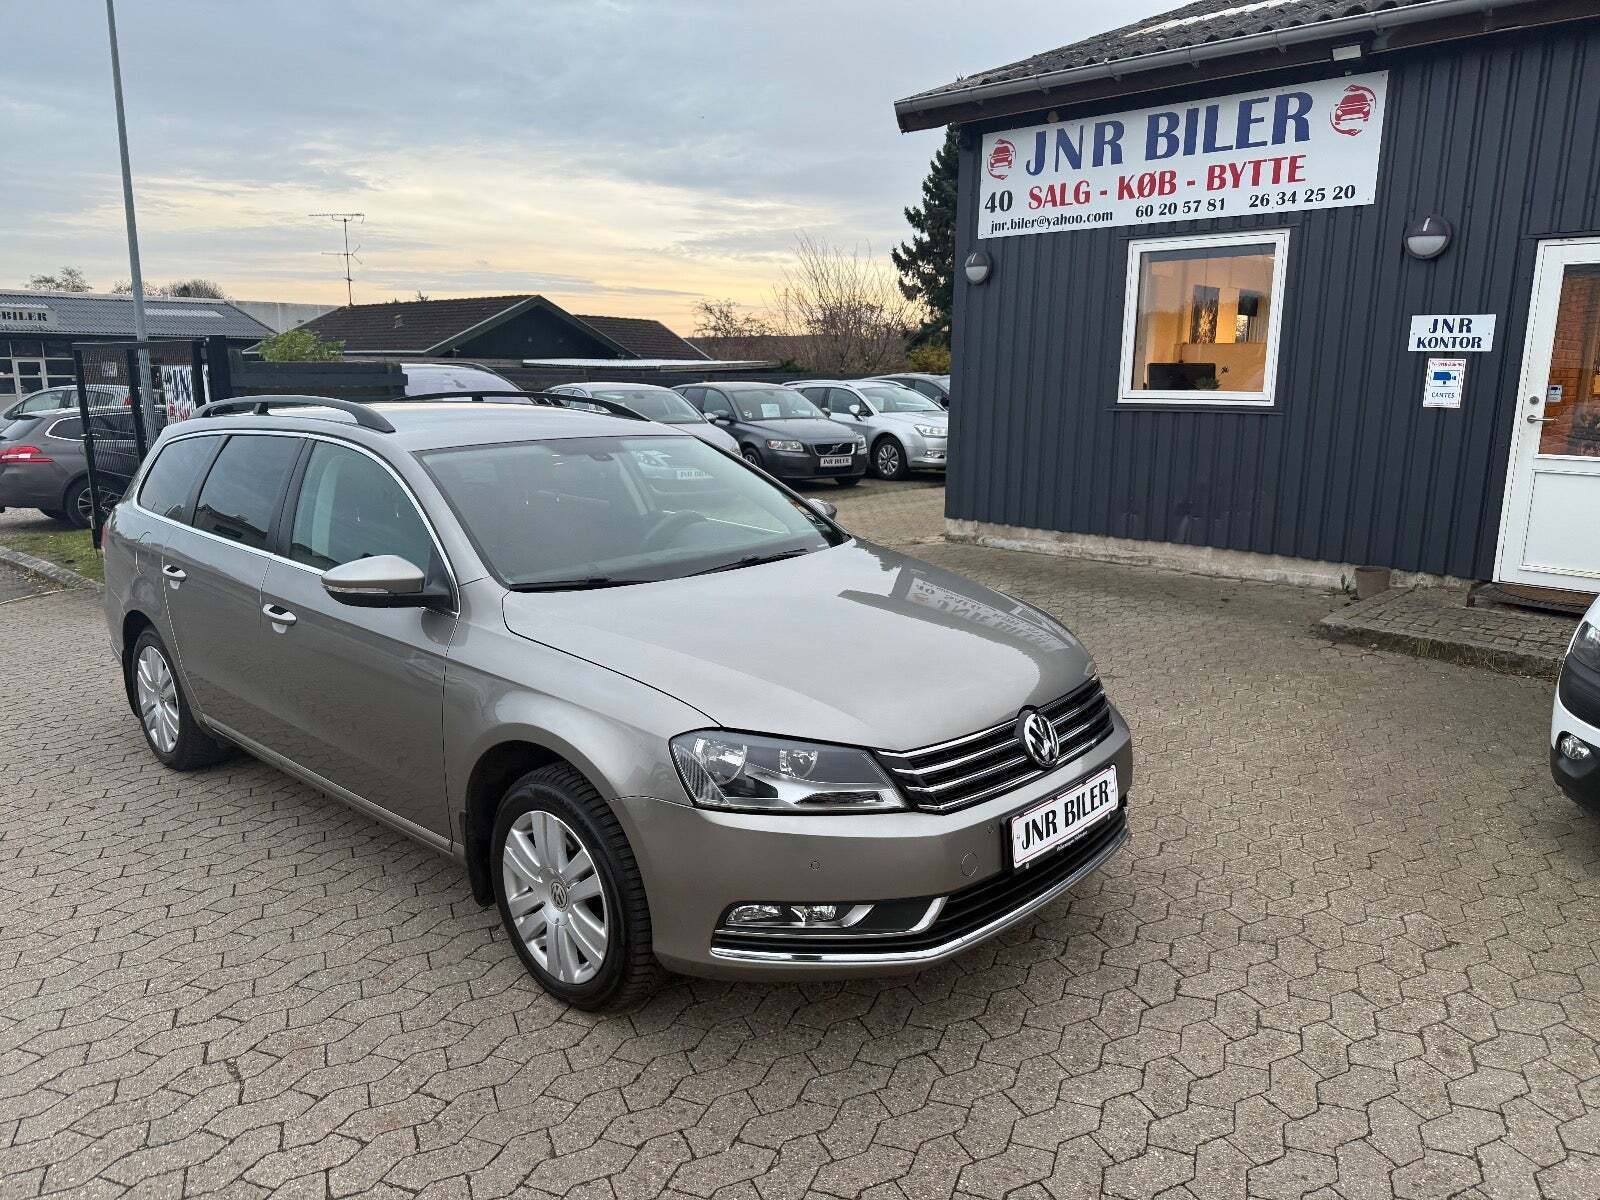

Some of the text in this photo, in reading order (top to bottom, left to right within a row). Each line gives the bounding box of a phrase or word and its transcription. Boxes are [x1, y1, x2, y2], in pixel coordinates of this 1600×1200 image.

[1026, 91, 1313, 176] JNR BILER
[985, 190, 1013, 213] 40
[1028, 180, 1091, 210] SALG
[1117, 169, 1177, 201] KØB
[1206, 154, 1307, 191] BYTTE
[990, 184, 1356, 234] jnr.biler@yahoo.com 60 20 57 81 26 34 25 20
[1416, 336, 1483, 349] KONTOR
[1428, 317, 1473, 334] JNR
[1021, 809, 1058, 850] JNR
[1064, 779, 1109, 828] BILER
